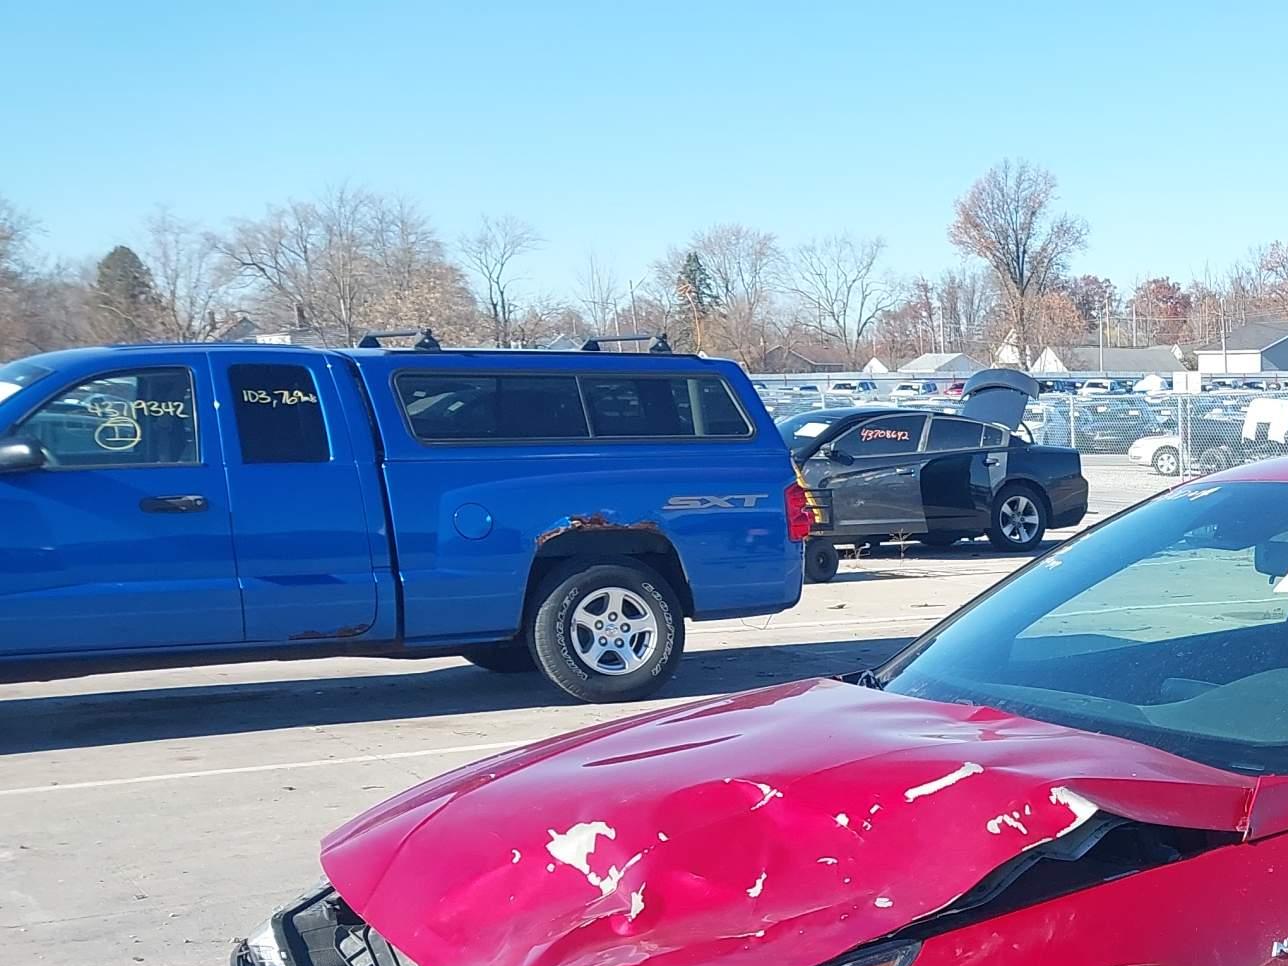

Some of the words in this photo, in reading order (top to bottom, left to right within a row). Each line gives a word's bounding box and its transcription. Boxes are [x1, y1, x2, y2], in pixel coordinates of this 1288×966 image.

[87, 400, 190, 420] 43719342
[662, 494, 769, 510] SXT
[641, 582, 675, 677] GOODYEAR
